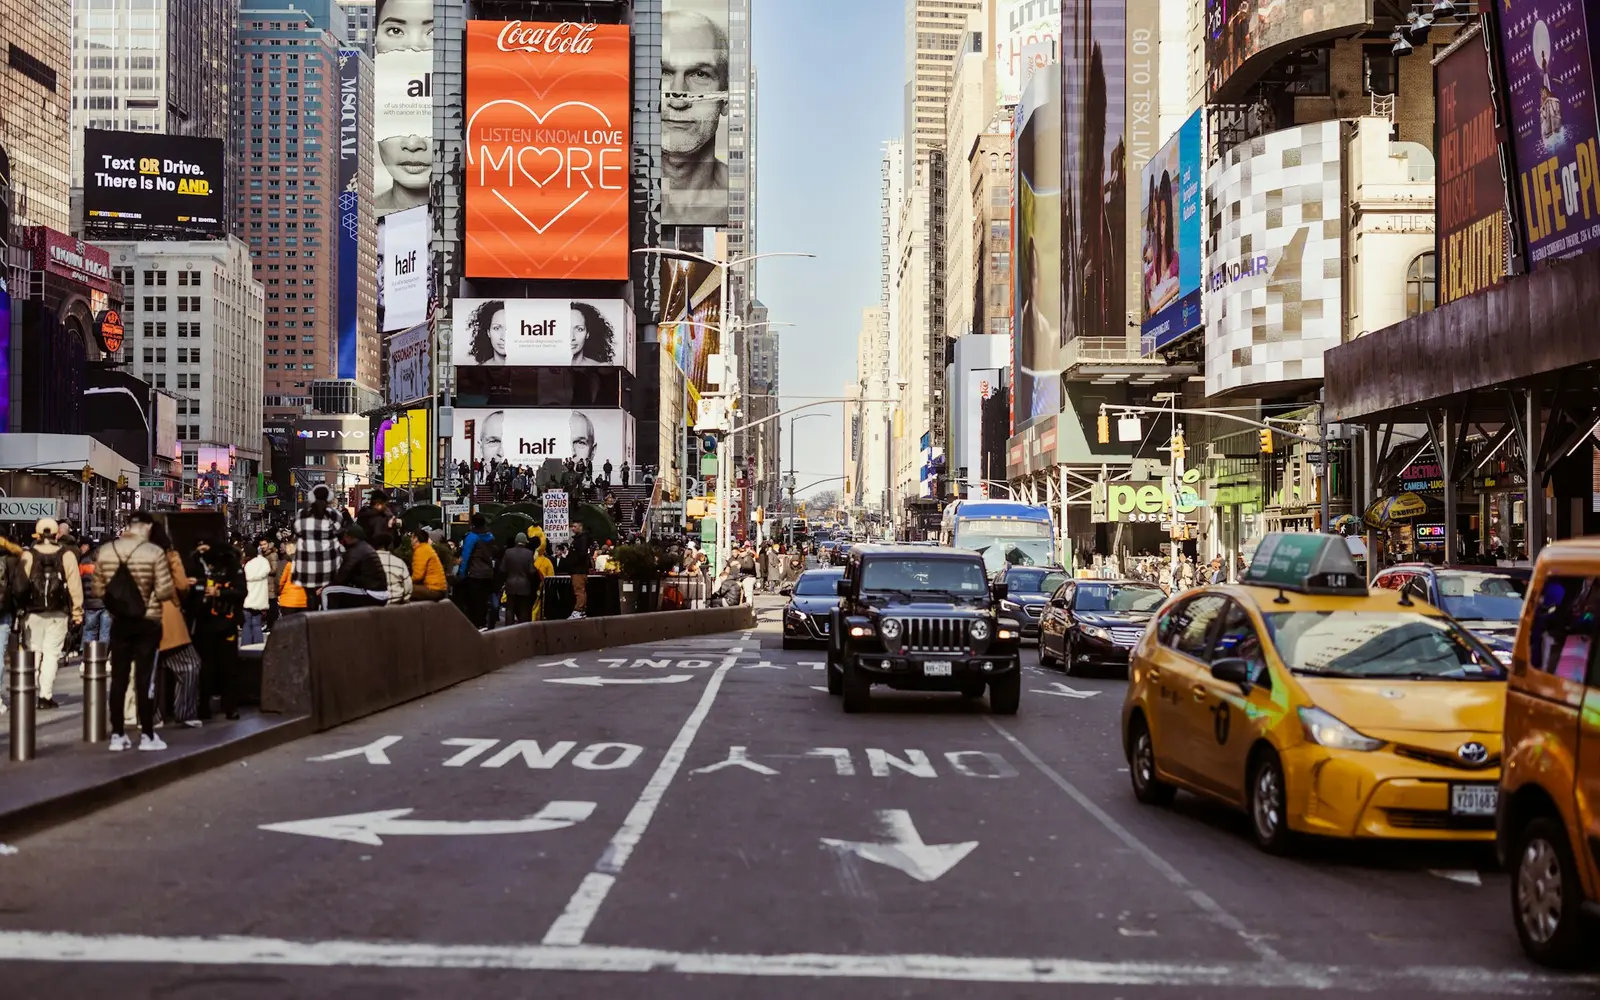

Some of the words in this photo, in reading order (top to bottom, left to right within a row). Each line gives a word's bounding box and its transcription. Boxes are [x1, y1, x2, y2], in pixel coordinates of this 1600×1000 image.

[497, 20, 599, 55] Coca-Cola
[1132, 29, 1150, 55] GO
[1132, 60, 1150, 84] TO
[1441, 82, 1457, 135] THE
[480, 127, 532, 144] LISTEN
[535, 129, 581, 145] KNOW
[583, 130, 623, 145] LOVE
[1132, 90, 1150, 171] TSX.LIVE
[102, 155, 136, 171] Text
[139, 158, 160, 174] OR
[163, 159, 204, 176] Drive.
[1441, 129, 1461, 183] NEIL
[94, 172, 137, 189] There
[140, 176, 153, 190] Is
[156, 177, 175, 191] No
[1441, 167, 1477, 233] MUSICAL
[1521, 156, 1567, 244] LIFE
[1561, 162, 1580, 217] OF
[395, 250, 417, 276] half
[1441, 238, 1449, 305] A
[520, 319, 557, 336] half
[519, 437, 556, 455] half
[1403, 481, 1428, 491] CAMERA
[545, 499, 567, 508] JESUS
[1128, 513, 1186, 522] SOCCR
[1419, 527, 1445, 535] OPEN
[537, 657, 713, 669] ONLY
[305, 735, 644, 770] ONLY
[688, 746, 1020, 778] ONLY
